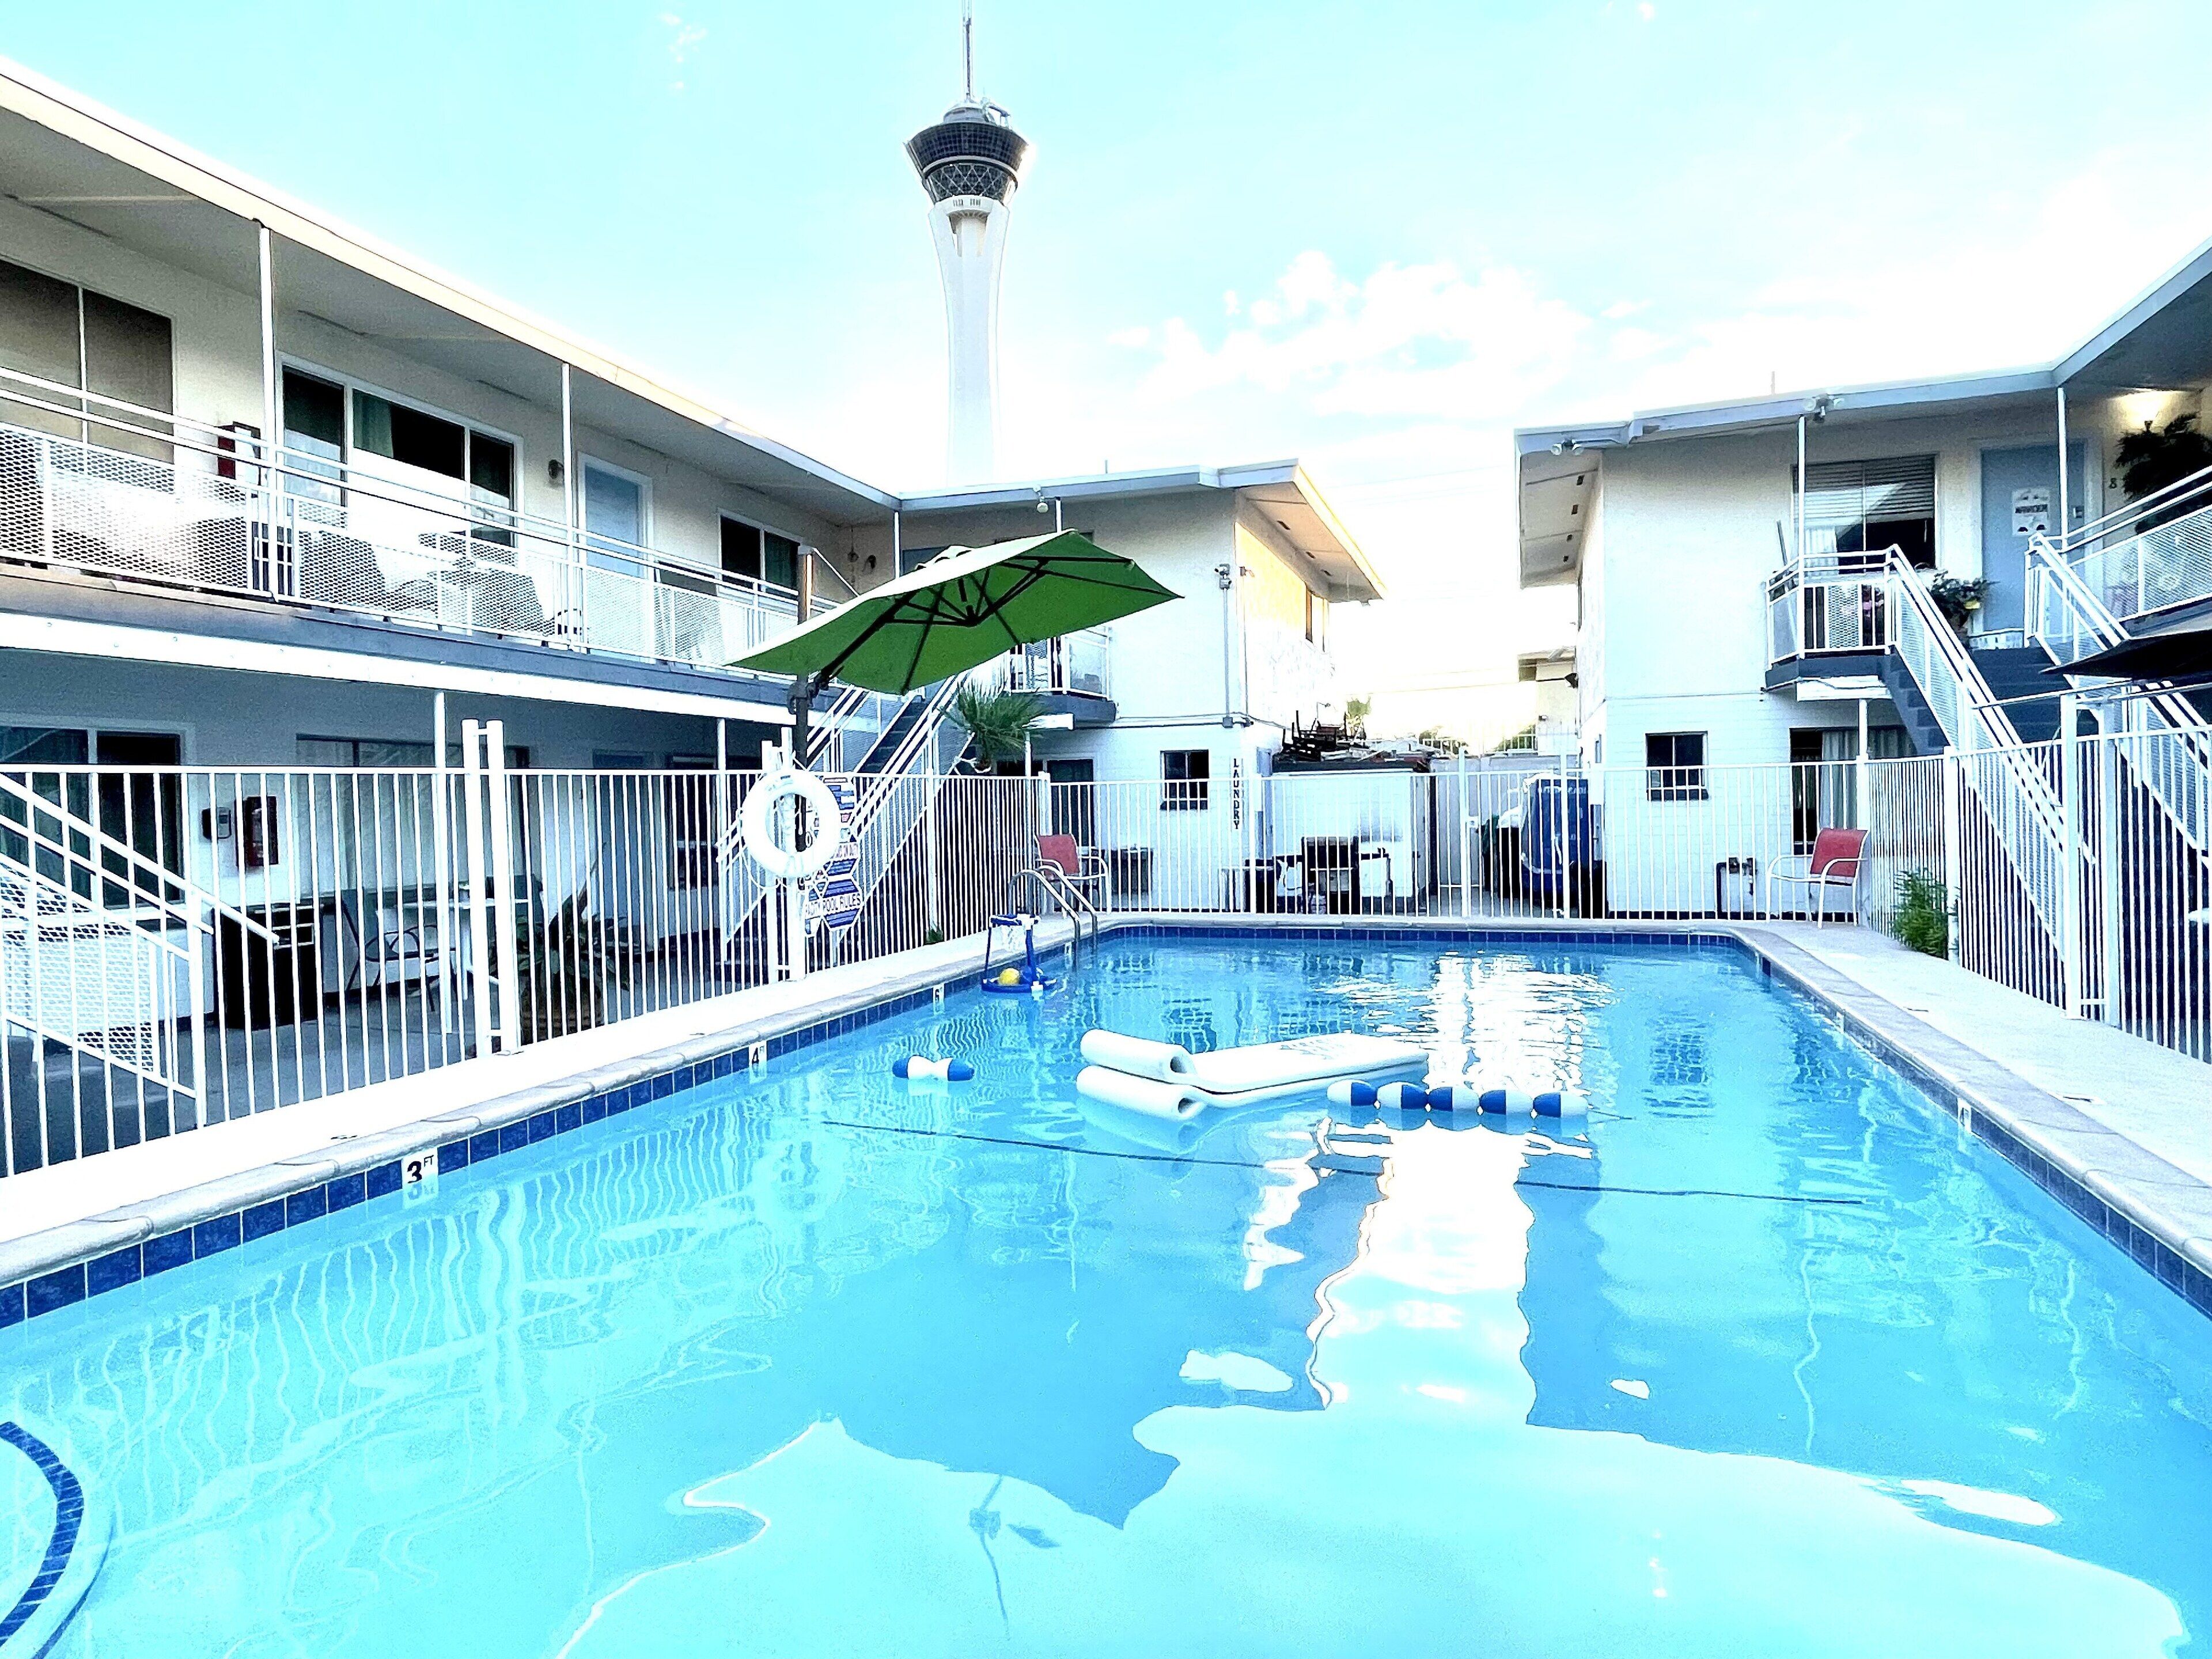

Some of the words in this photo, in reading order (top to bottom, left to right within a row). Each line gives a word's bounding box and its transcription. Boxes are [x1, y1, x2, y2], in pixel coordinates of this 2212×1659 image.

[823, 897, 838, 912] POOL
[839, 892, 861, 910] RULES
[752, 1047, 759, 1065] 4
[407, 1160, 423, 1184] 3
[423, 1154, 434, 1167] FT
